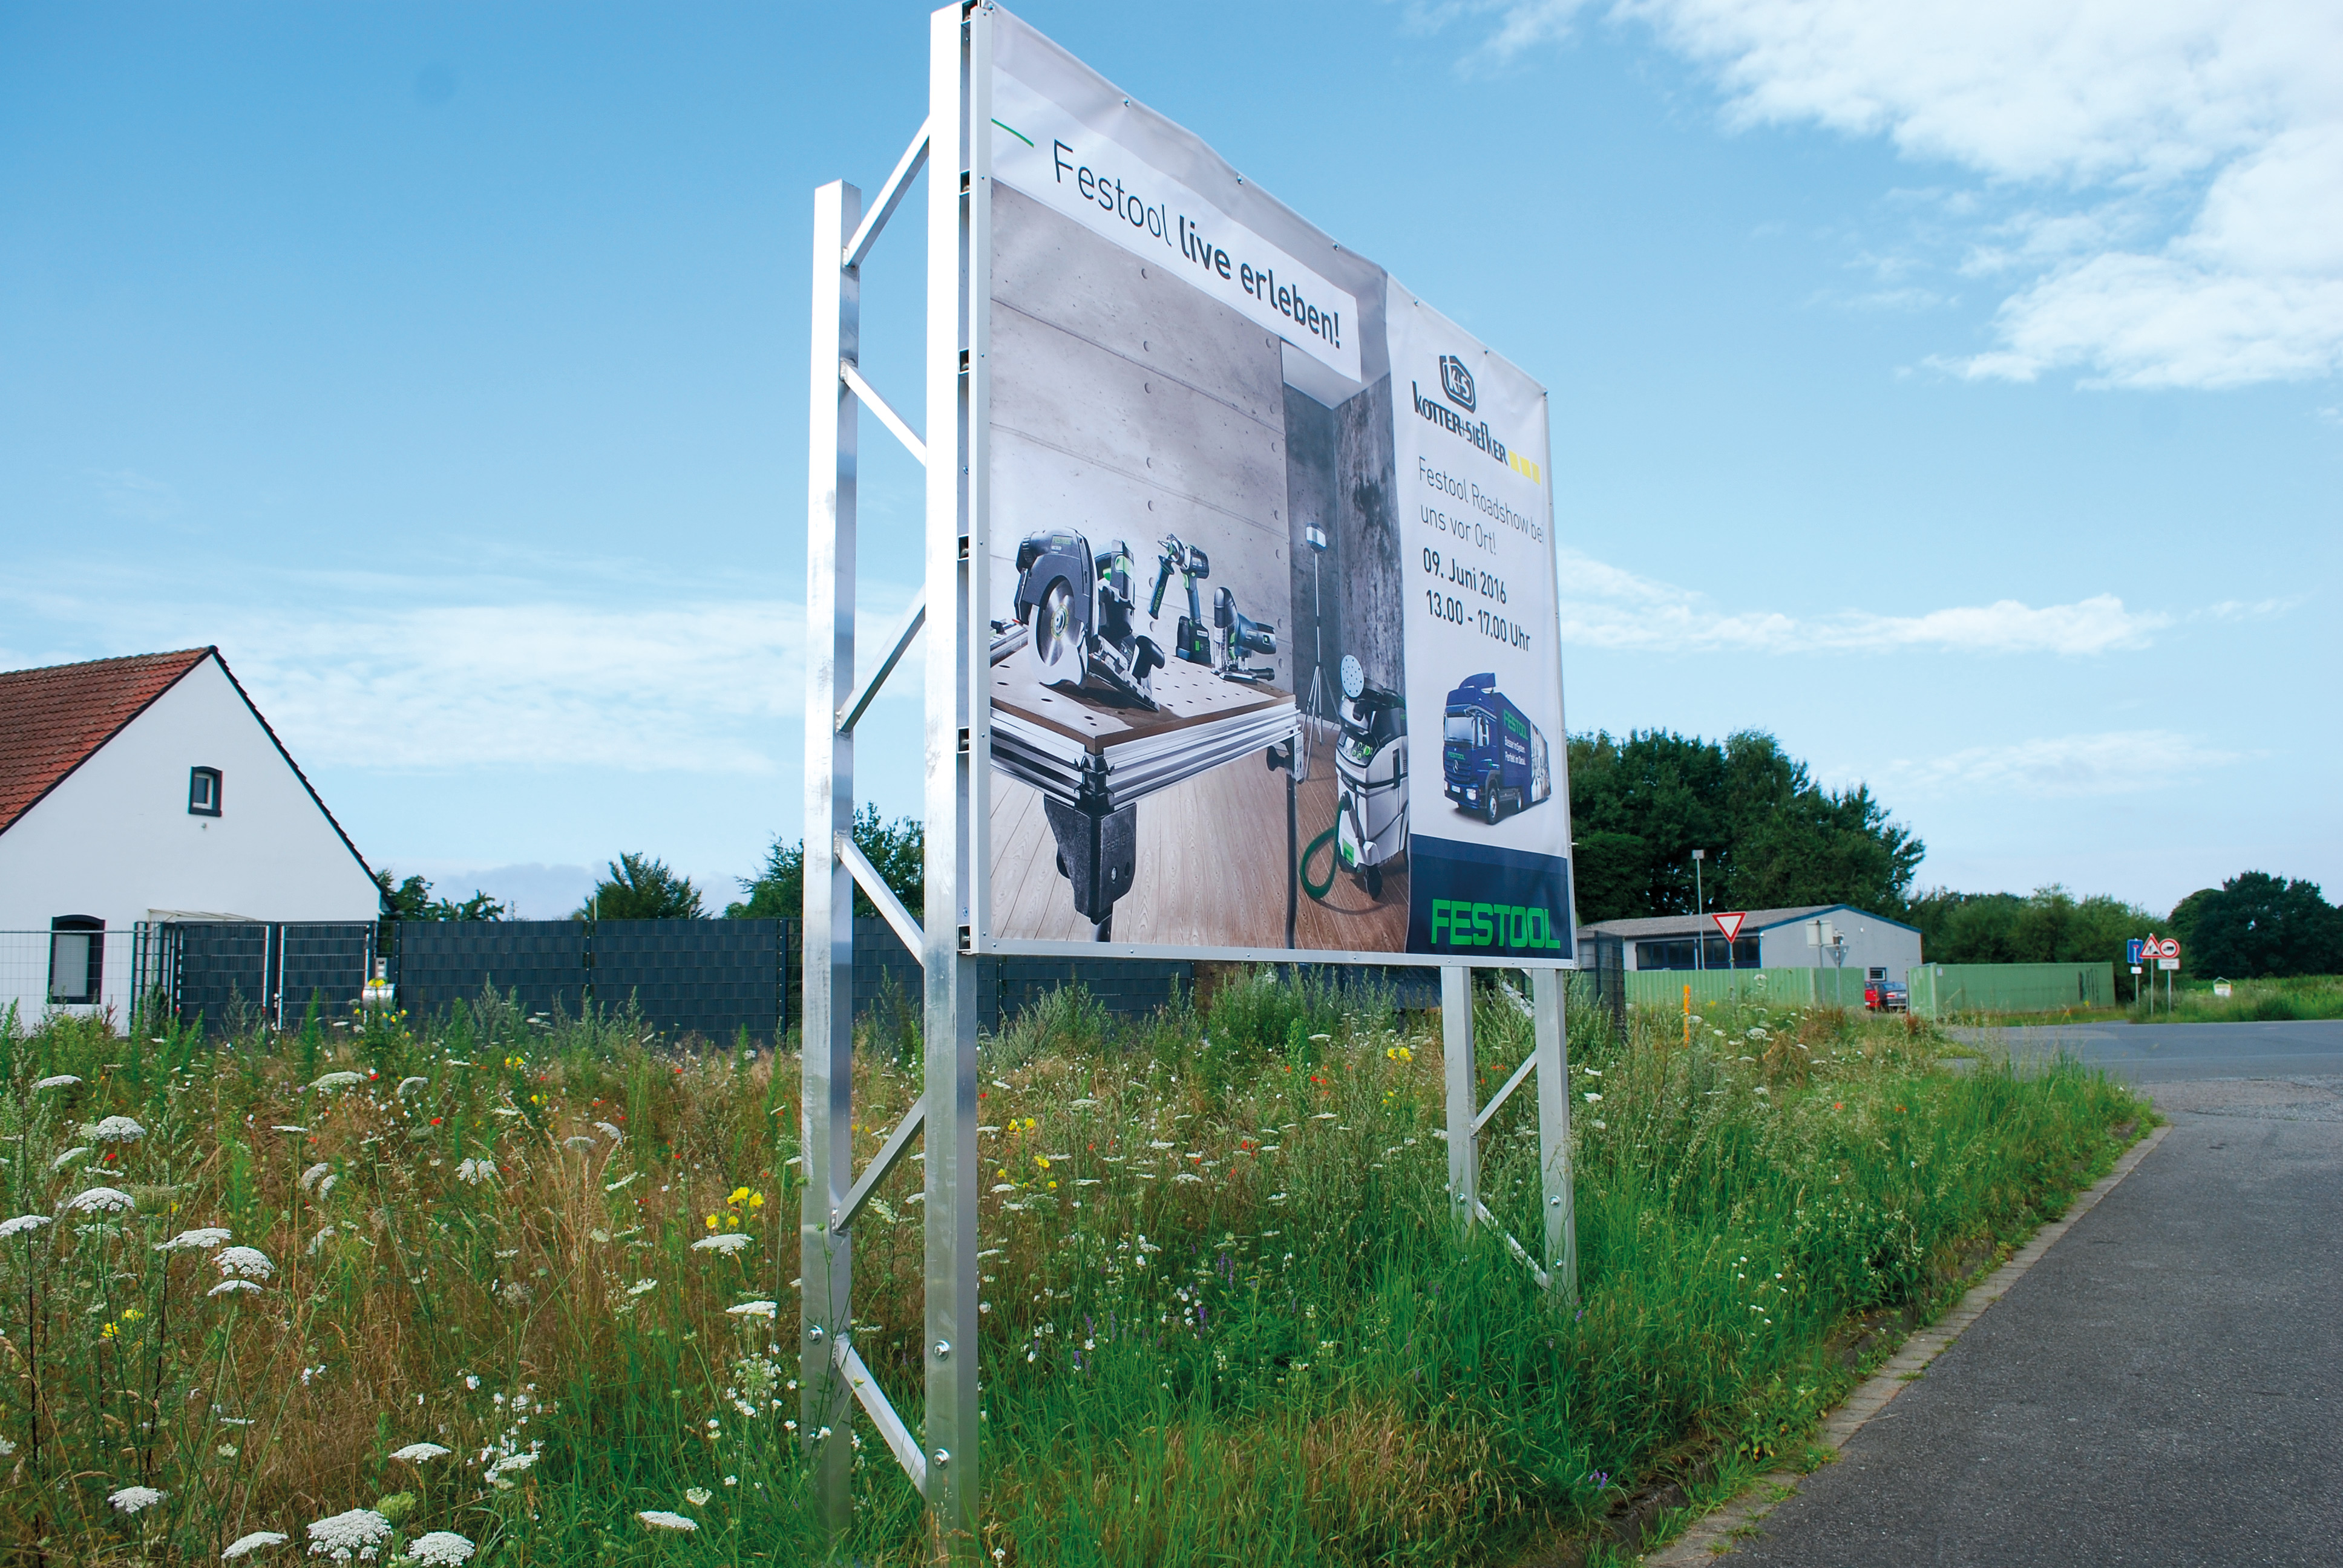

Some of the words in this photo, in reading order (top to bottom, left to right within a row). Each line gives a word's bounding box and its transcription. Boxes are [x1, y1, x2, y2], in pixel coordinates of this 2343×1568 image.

[1054, 139, 1172, 247] Festool
[1179, 214, 1231, 280] live
[1240, 263, 1340, 349] erleben!
[1419, 456, 1469, 503] Festool
[1472, 483, 1529, 535] Roadshow
[1420, 505, 1446, 531] uns
[1450, 517, 1471, 541] vor
[1475, 523, 1496, 555] Ort!
[1423, 547, 1444, 578] 09.
[1448, 558, 1476, 592] Juni
[1480, 570, 1507, 604] 2016
[1426, 589, 1463, 626] 13.00
[1478, 609, 1507, 642] 17.00
[1510, 621, 1530, 652] Uhr
[1430, 899, 1561, 949] FESTOOL
